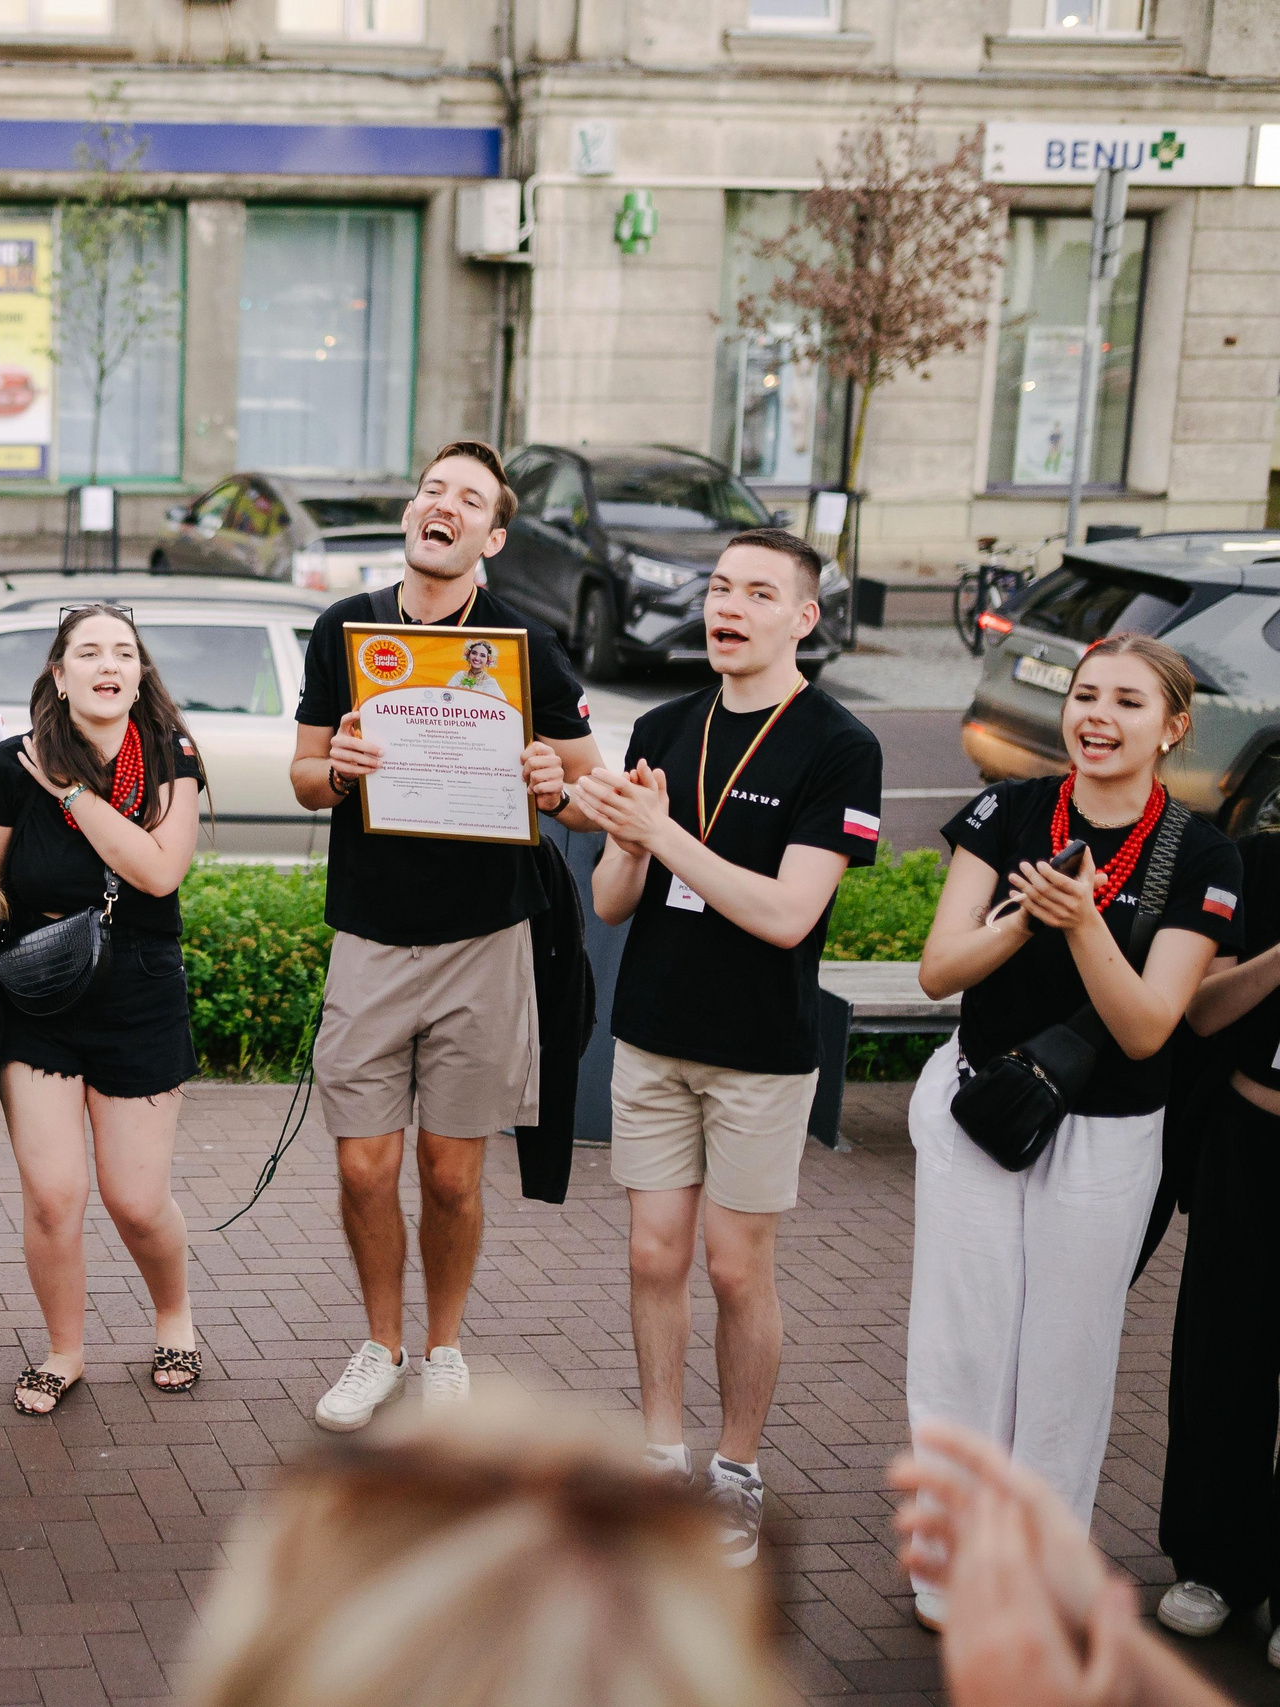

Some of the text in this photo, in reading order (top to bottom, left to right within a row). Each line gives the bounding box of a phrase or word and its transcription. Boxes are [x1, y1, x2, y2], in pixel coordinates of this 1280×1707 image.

[1045, 139, 1144, 170] BENU
[375, 704, 506, 721] LAUREATO DIPLOMAS
[405, 717, 477, 728] LAUREATE DIPLOMA
[727, 789, 781, 807] RAKUS
[966, 816, 982, 830] AGH
